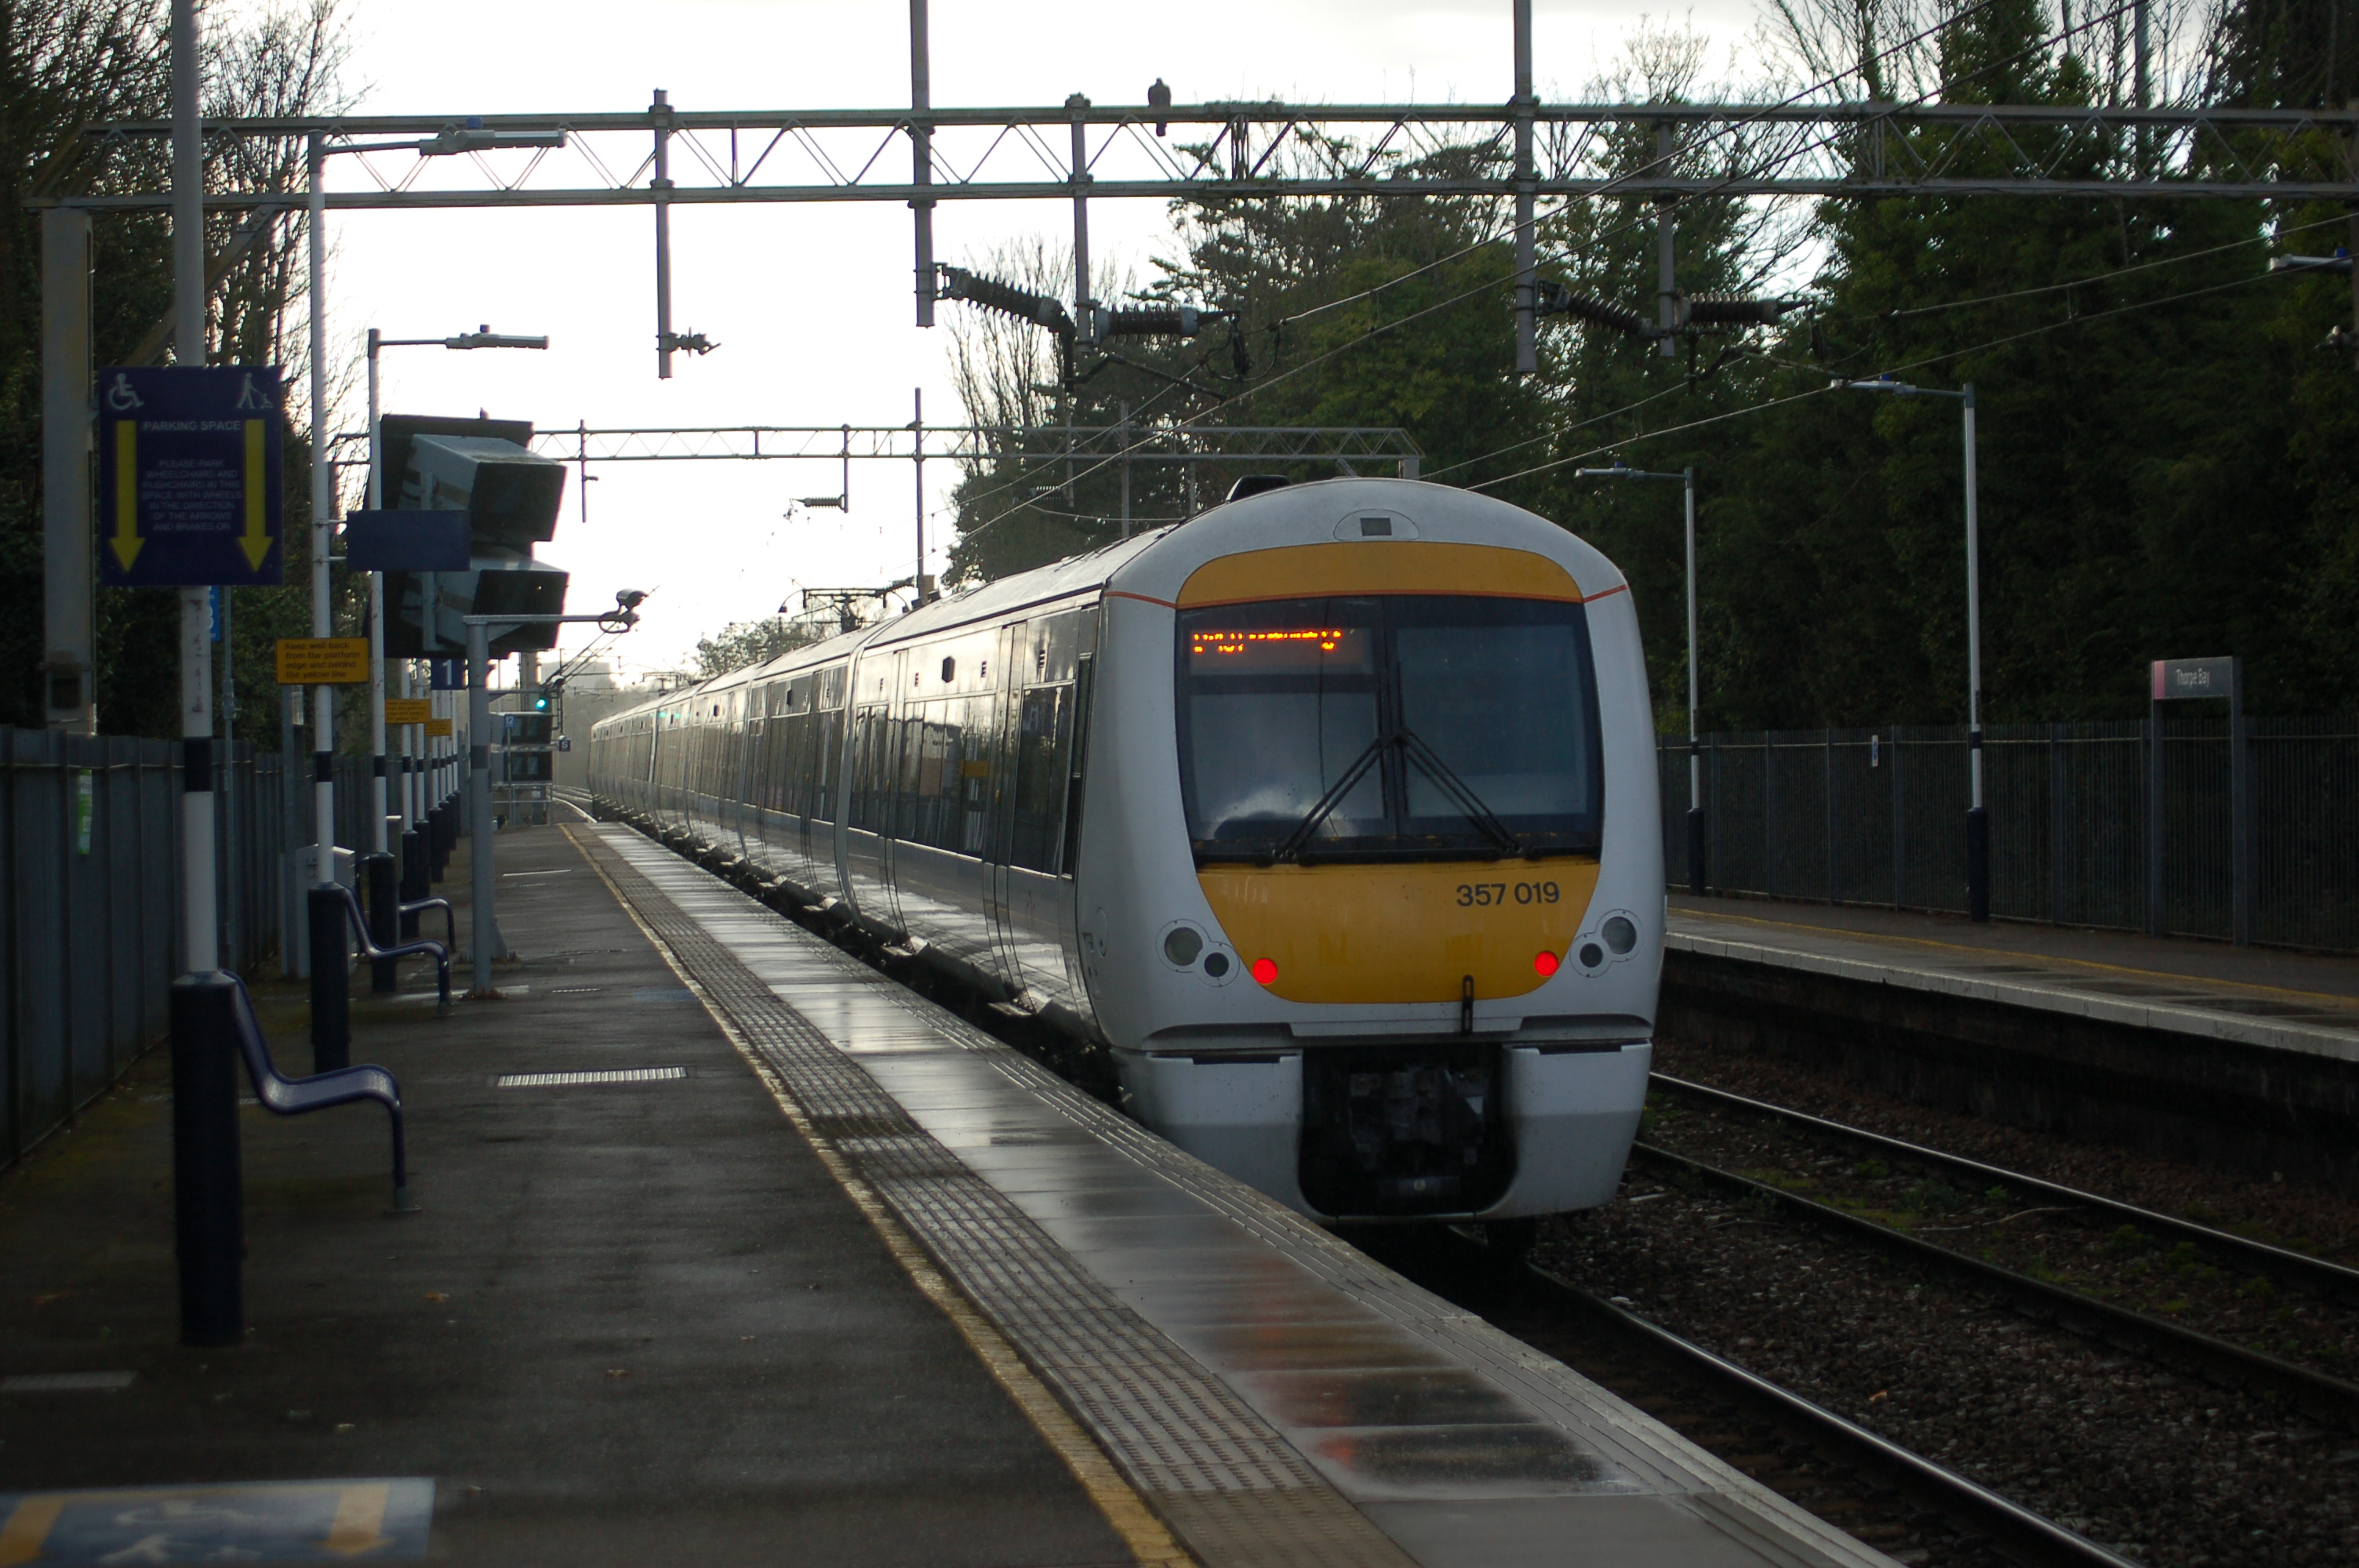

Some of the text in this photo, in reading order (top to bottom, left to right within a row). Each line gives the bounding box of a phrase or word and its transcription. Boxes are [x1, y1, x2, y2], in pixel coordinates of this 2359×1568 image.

[144, 420, 242, 431] PARKING SPACE
[159, 459, 225, 468] PLEASE PARK
[146, 470, 238, 478] WHEELCHAIRS AND
[143, 481, 205, 489] PUSHCHAIRS
[219, 480, 241, 488] THIS
[142, 491, 174, 499] SPACE
[203, 490, 242, 499] WHEELS
[162, 501, 181, 510] THE
[183, 501, 234, 510] DIRECTION
[153, 512, 165, 521] OF
[190, 511, 232, 520] ARROWS
[176, 522, 214, 531] BRAKES
[216, 522, 231, 531] ON
[442, 659, 452, 685] 1
[2175, 667, 2211, 688] Thorpe Bay
[506, 716, 514, 724] 12
[562, 740, 569, 749] S
[1456, 881, 1560, 906] 357 019
